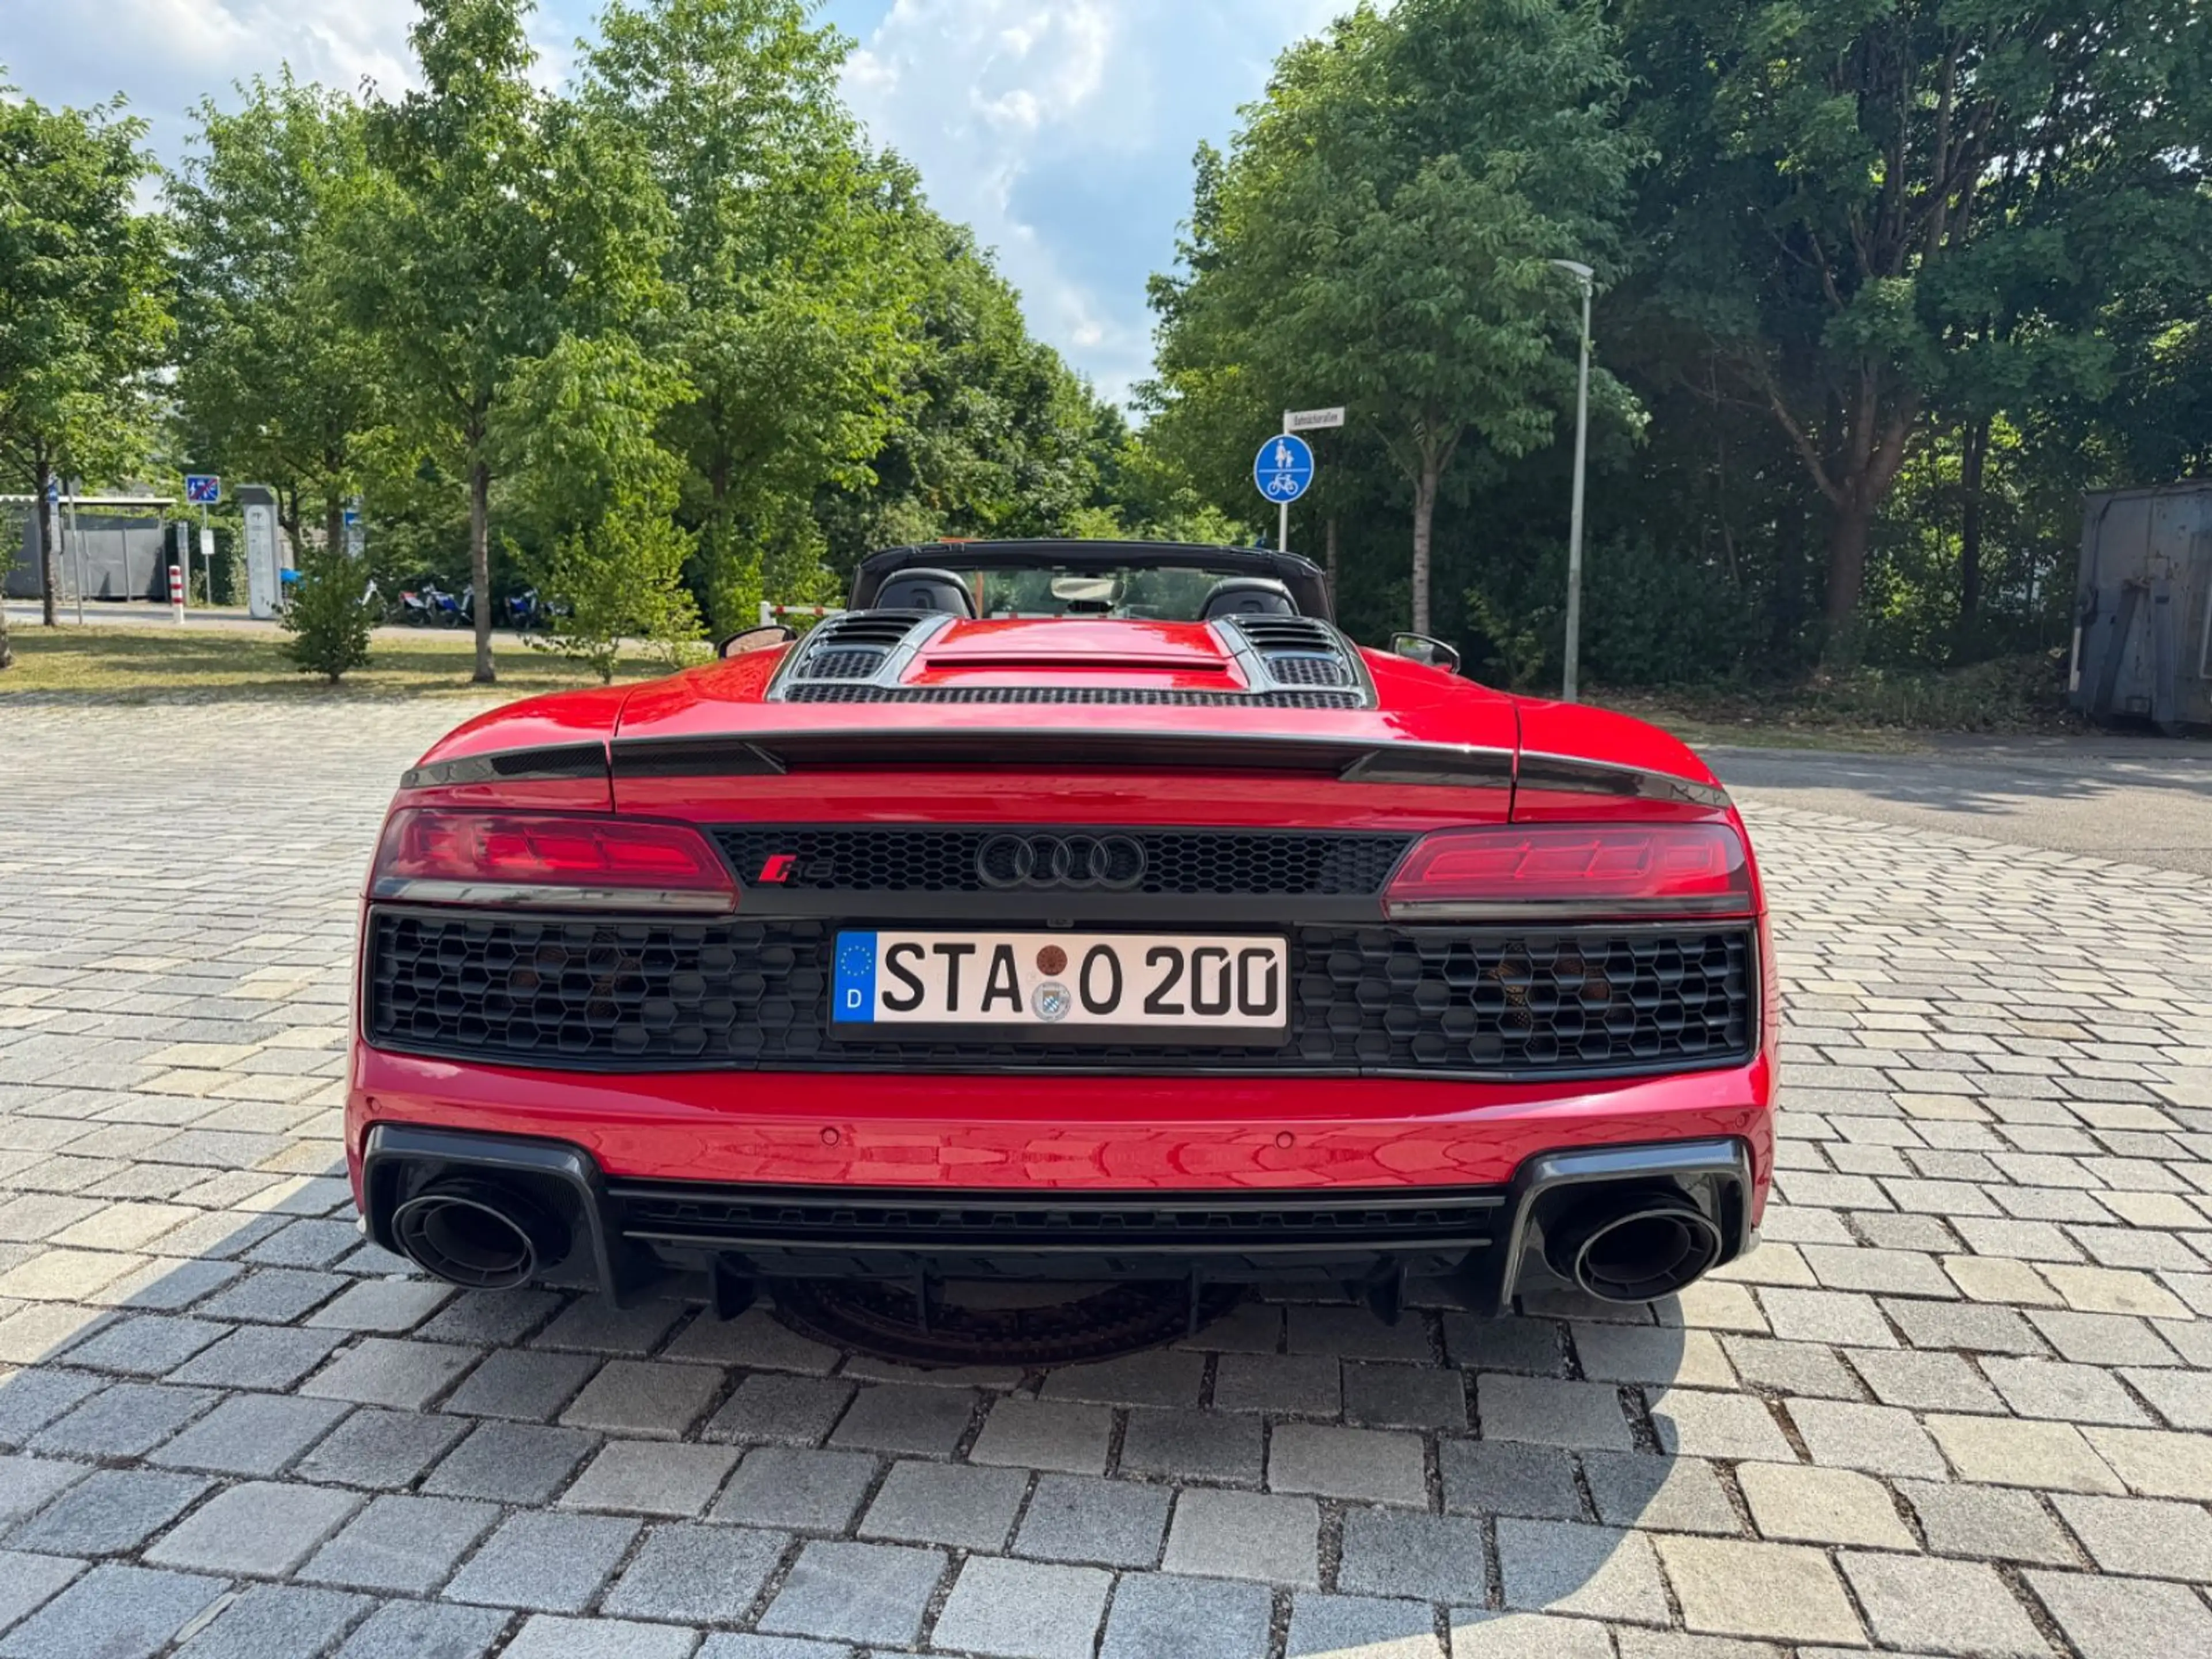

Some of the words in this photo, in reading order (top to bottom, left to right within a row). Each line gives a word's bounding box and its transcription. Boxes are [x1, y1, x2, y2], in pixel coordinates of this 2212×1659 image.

[847, 988, 862, 1008] D
[882, 942, 1023, 1012] STA
[1080, 944, 1122, 1015] O
[1143, 945, 1278, 1016] 200
